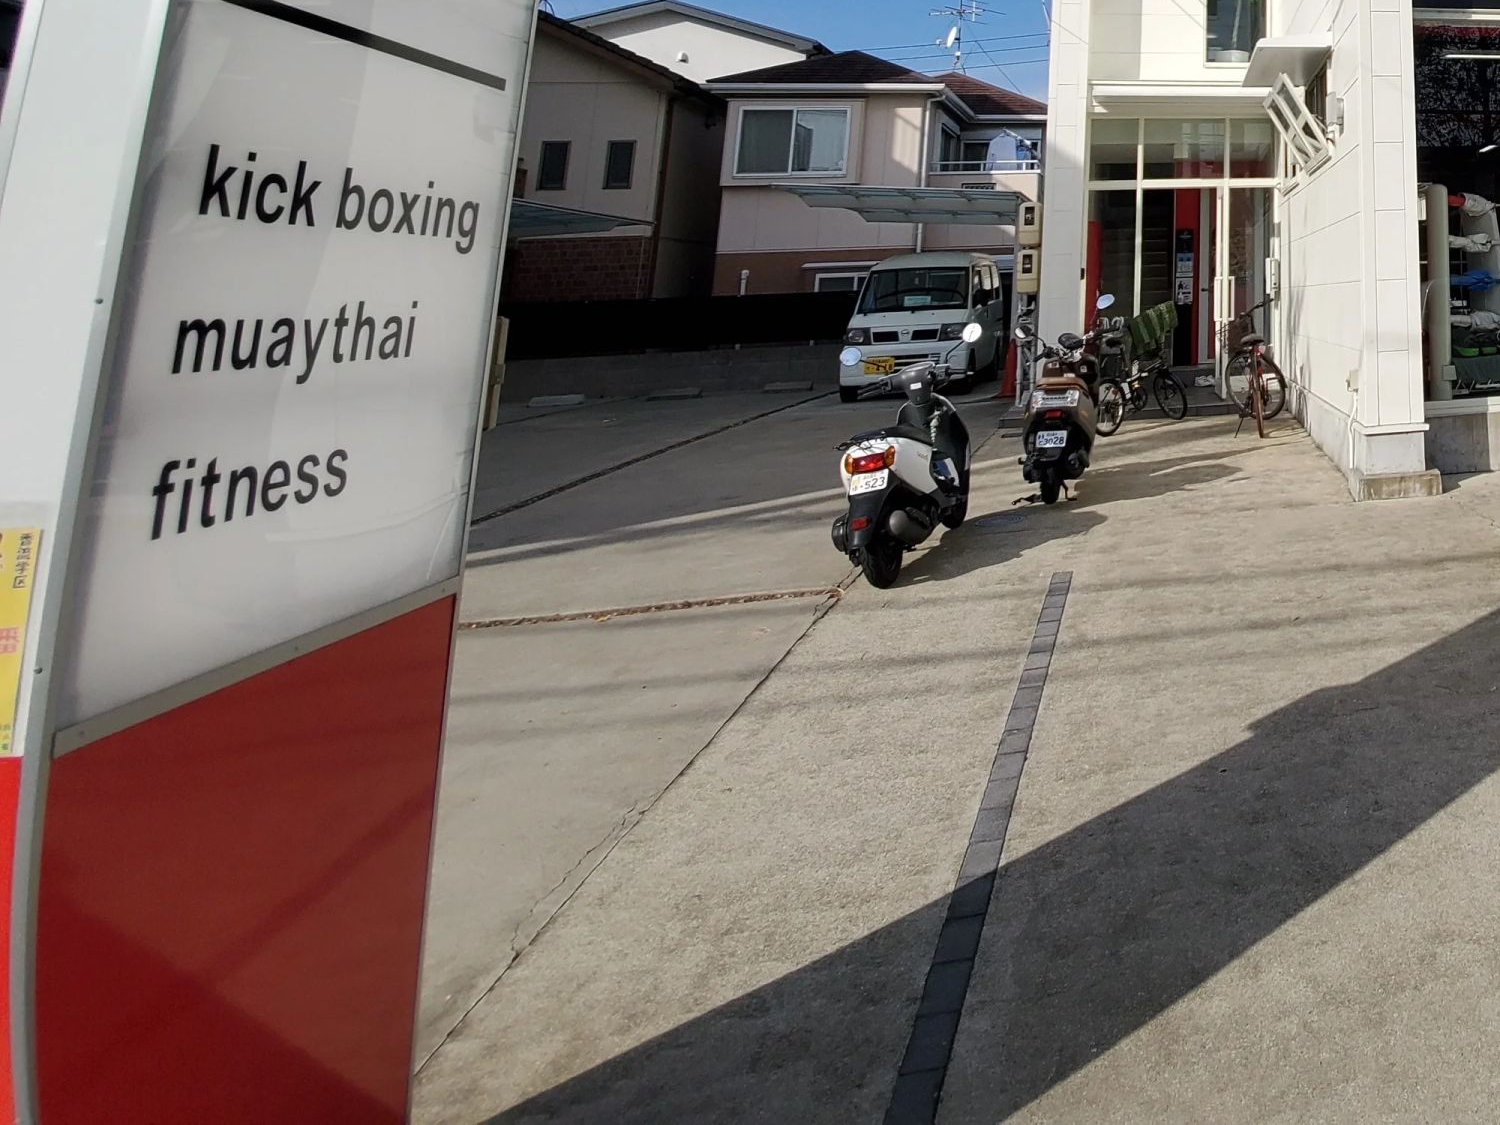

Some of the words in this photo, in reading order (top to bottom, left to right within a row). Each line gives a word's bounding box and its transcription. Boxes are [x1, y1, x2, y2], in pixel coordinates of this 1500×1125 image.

[199, 143, 322, 228] kick
[336, 166, 480, 254] boxing
[171, 301, 419, 384] muaythai
[150, 447, 349, 541] fitness
